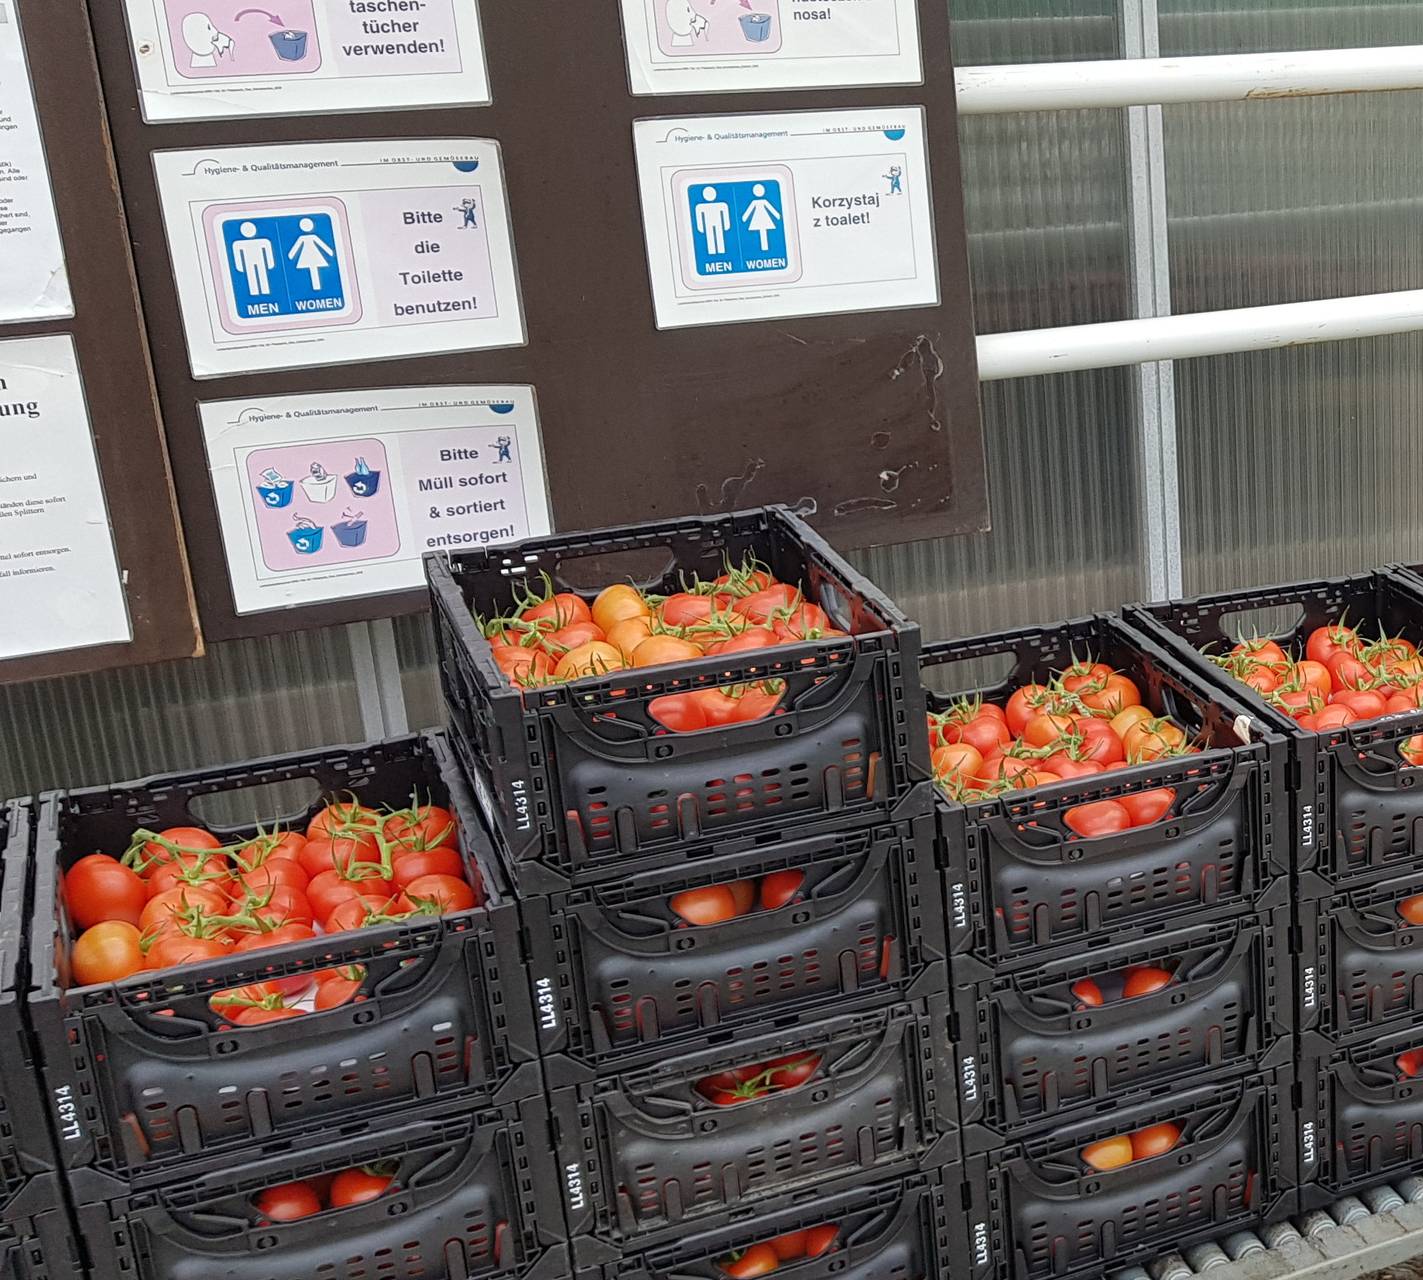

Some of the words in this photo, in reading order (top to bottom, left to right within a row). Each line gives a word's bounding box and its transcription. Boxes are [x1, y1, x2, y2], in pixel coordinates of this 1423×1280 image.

[349, 0, 426, 13] taschen-
[793, 8, 831, 20] nosa!
[362, 19, 419, 34] tücher
[342, 38, 445, 56] verwenden!
[714, 131, 788, 140] Qualitätsmanagement
[204, 166, 240, 176] Hygiene-
[250, 161, 339, 172] Qualitätsmanagement
[812, 192, 880, 210] Korzystaj
[403, 211, 443, 225] Bitte
[813, 217, 822, 227] z
[825, 212, 870, 226] toalet!
[414, 240, 440, 254] die
[705, 261, 732, 273] MEN
[745, 258, 786, 270] WOMEN
[399, 269, 463, 285] Toilette
[247, 302, 279, 316] MEN
[295, 297, 343, 311] WOMEN
[394, 296, 478, 316] benutzen!
[249, 414, 283, 423] Hygiene-
[294, 405, 378, 418] Qualitätsmanagement
[440, 448, 479, 461] Bitte
[418, 476, 453, 492] Müll
[459, 471, 508, 487] sofort
[429, 506, 441, 519] &
[446, 499, 506, 517] sortiert
[426, 524, 515, 548] entsorgen!
[511, 780, 530, 830] LL4314
[1302, 805, 1313, 846] LL4314
[952, 883, 966, 928] LL4314
[1304, 967, 1315, 1007] LL4314
[536, 977, 557, 1029] LL4314
[963, 1056, 977, 1101] LL4314
[55, 1085, 81, 1140] LL4314
[1303, 1121, 1314, 1163] LL4314
[566, 1163, 585, 1210] LL4314
[974, 1222, 988, 1265] LL4314
